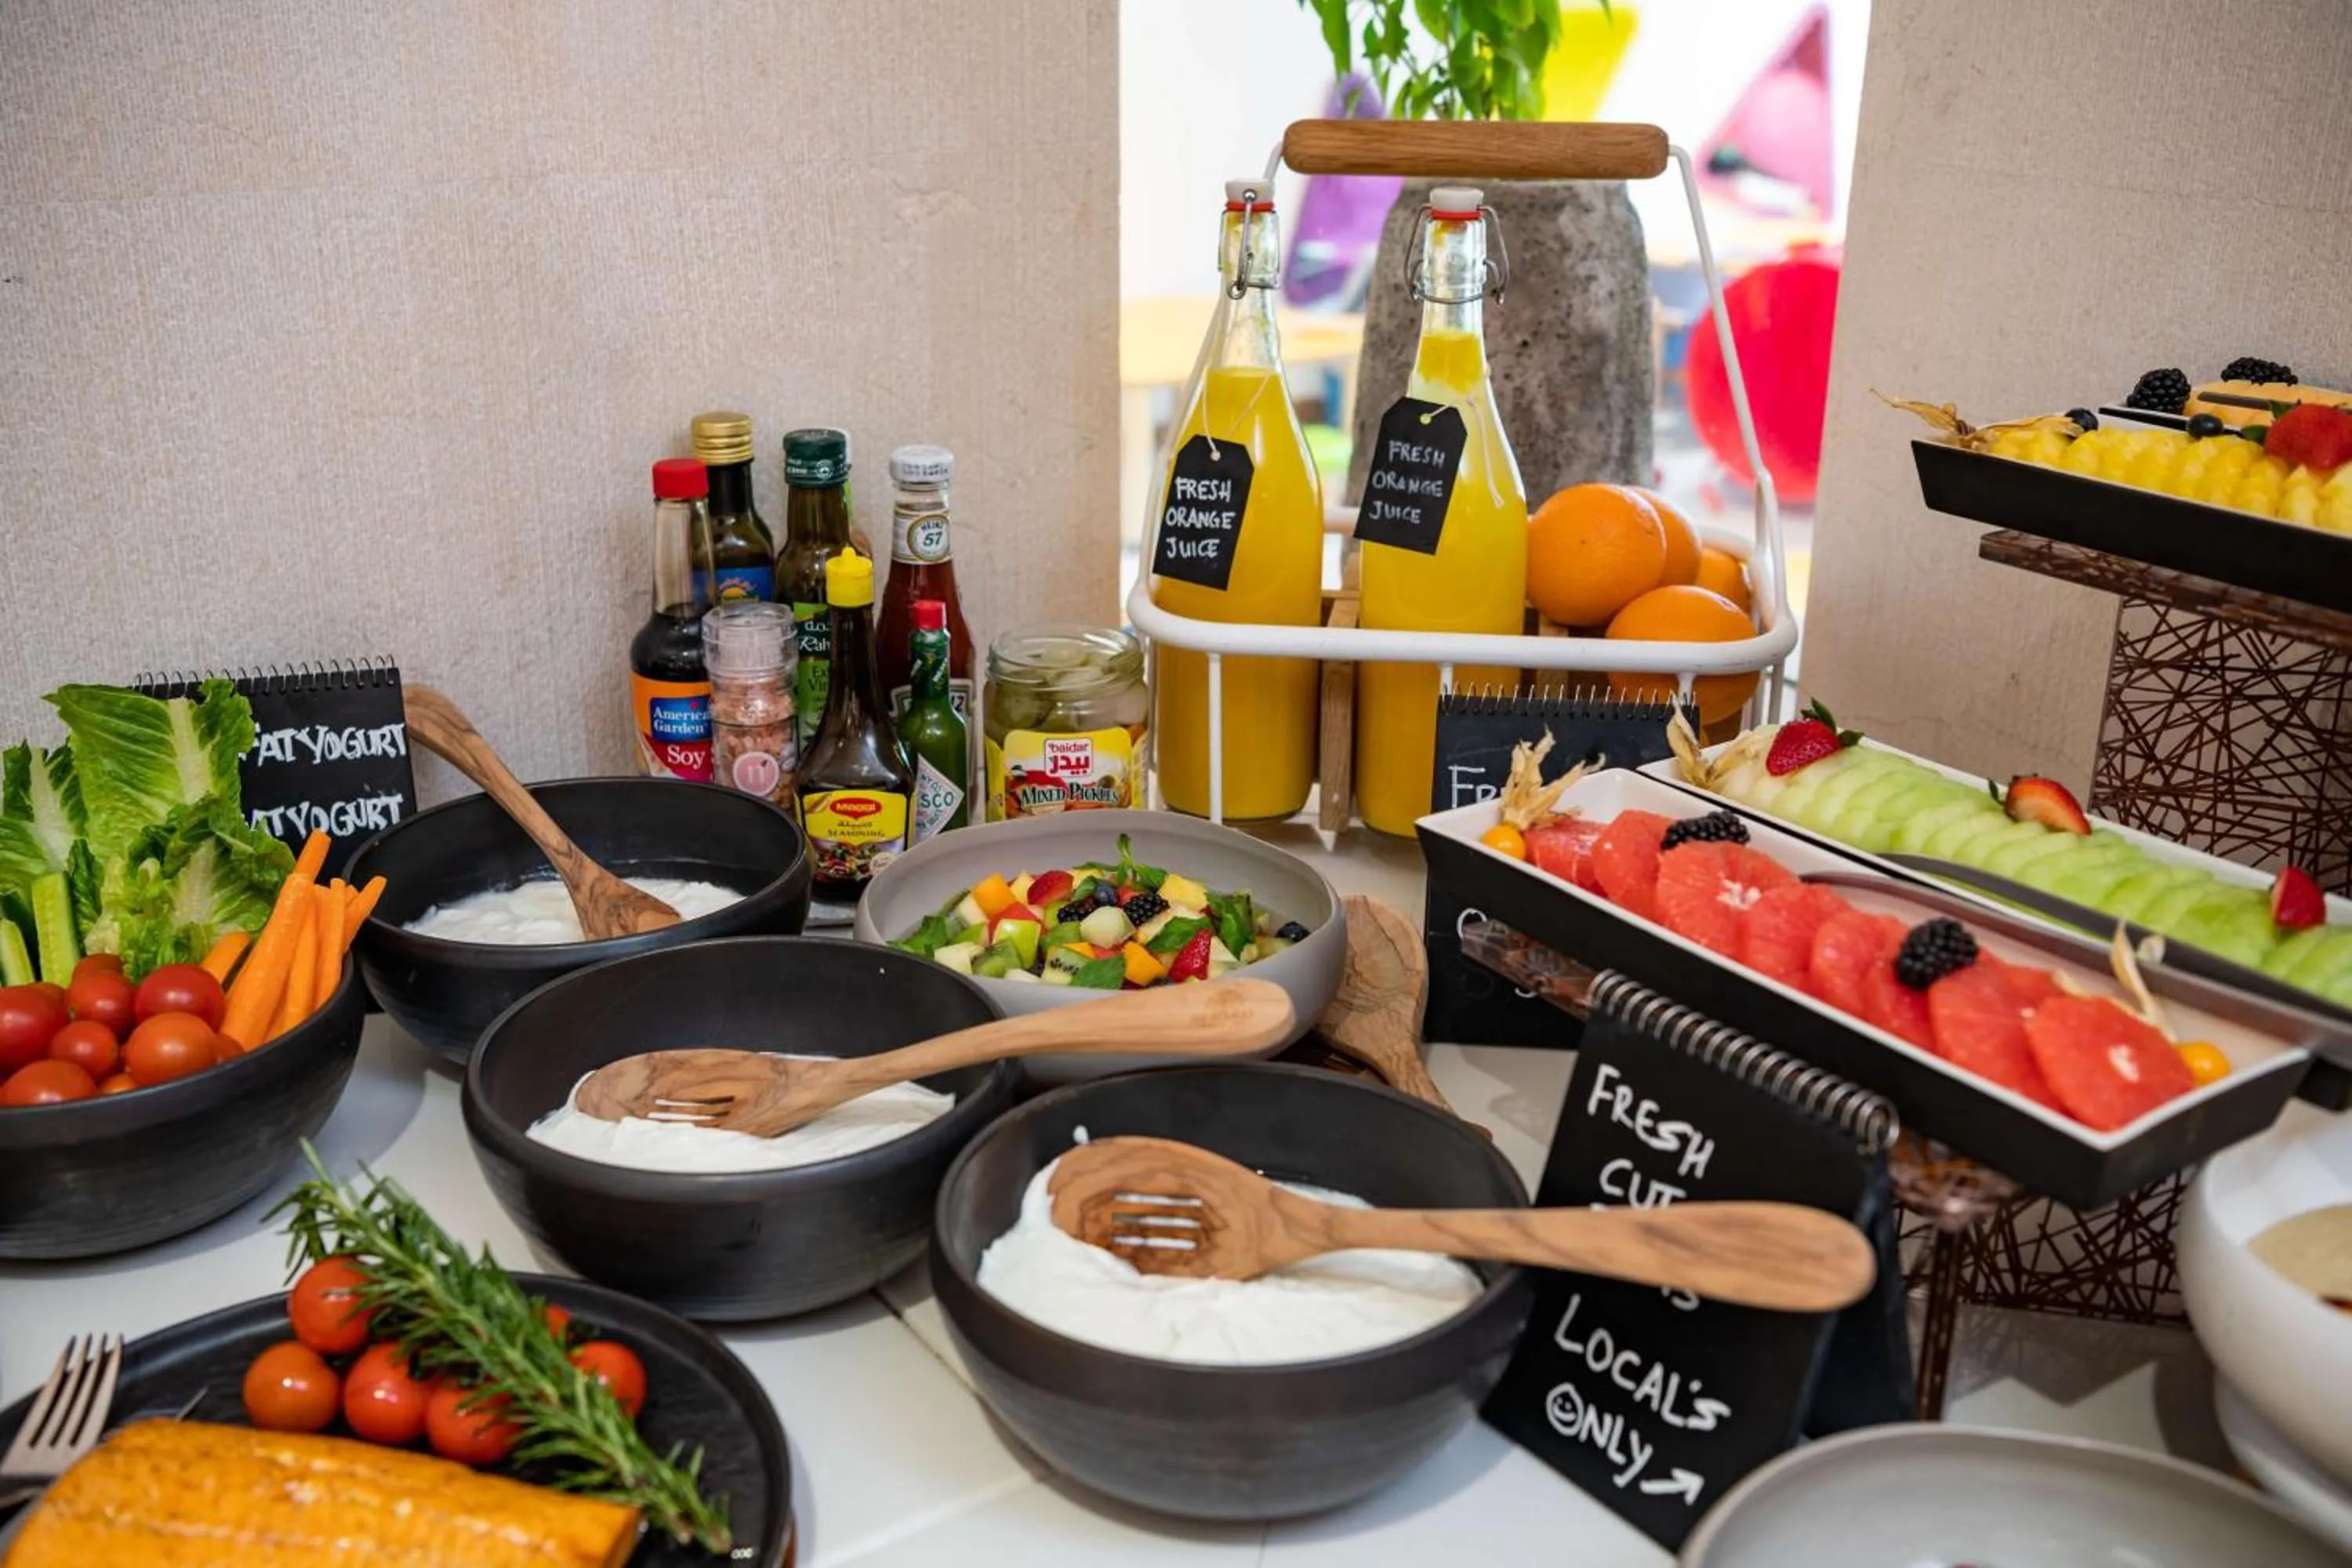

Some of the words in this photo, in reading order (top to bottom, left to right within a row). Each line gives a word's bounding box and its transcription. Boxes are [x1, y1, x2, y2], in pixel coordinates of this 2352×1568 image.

[1388, 440, 1445, 469] FRESH
[1174, 475, 1232, 503] FRESH
[1372, 470, 1444, 497] ORANGE
[1165, 506, 1236, 530] ORANGE
[1368, 499, 1422, 524] JUICE
[923, 532, 943, 546] 57
[1166, 537, 1221, 560] JUICE
[653, 706, 711, 720] America
[653, 719, 705, 735] Garden
[667, 744, 706, 770] Soy
[1049, 755, 1090, 775] بيدر
[1587, 1063, 1715, 1179] FRESH
[1553, 1292, 1732, 1432] LOCAL'S
